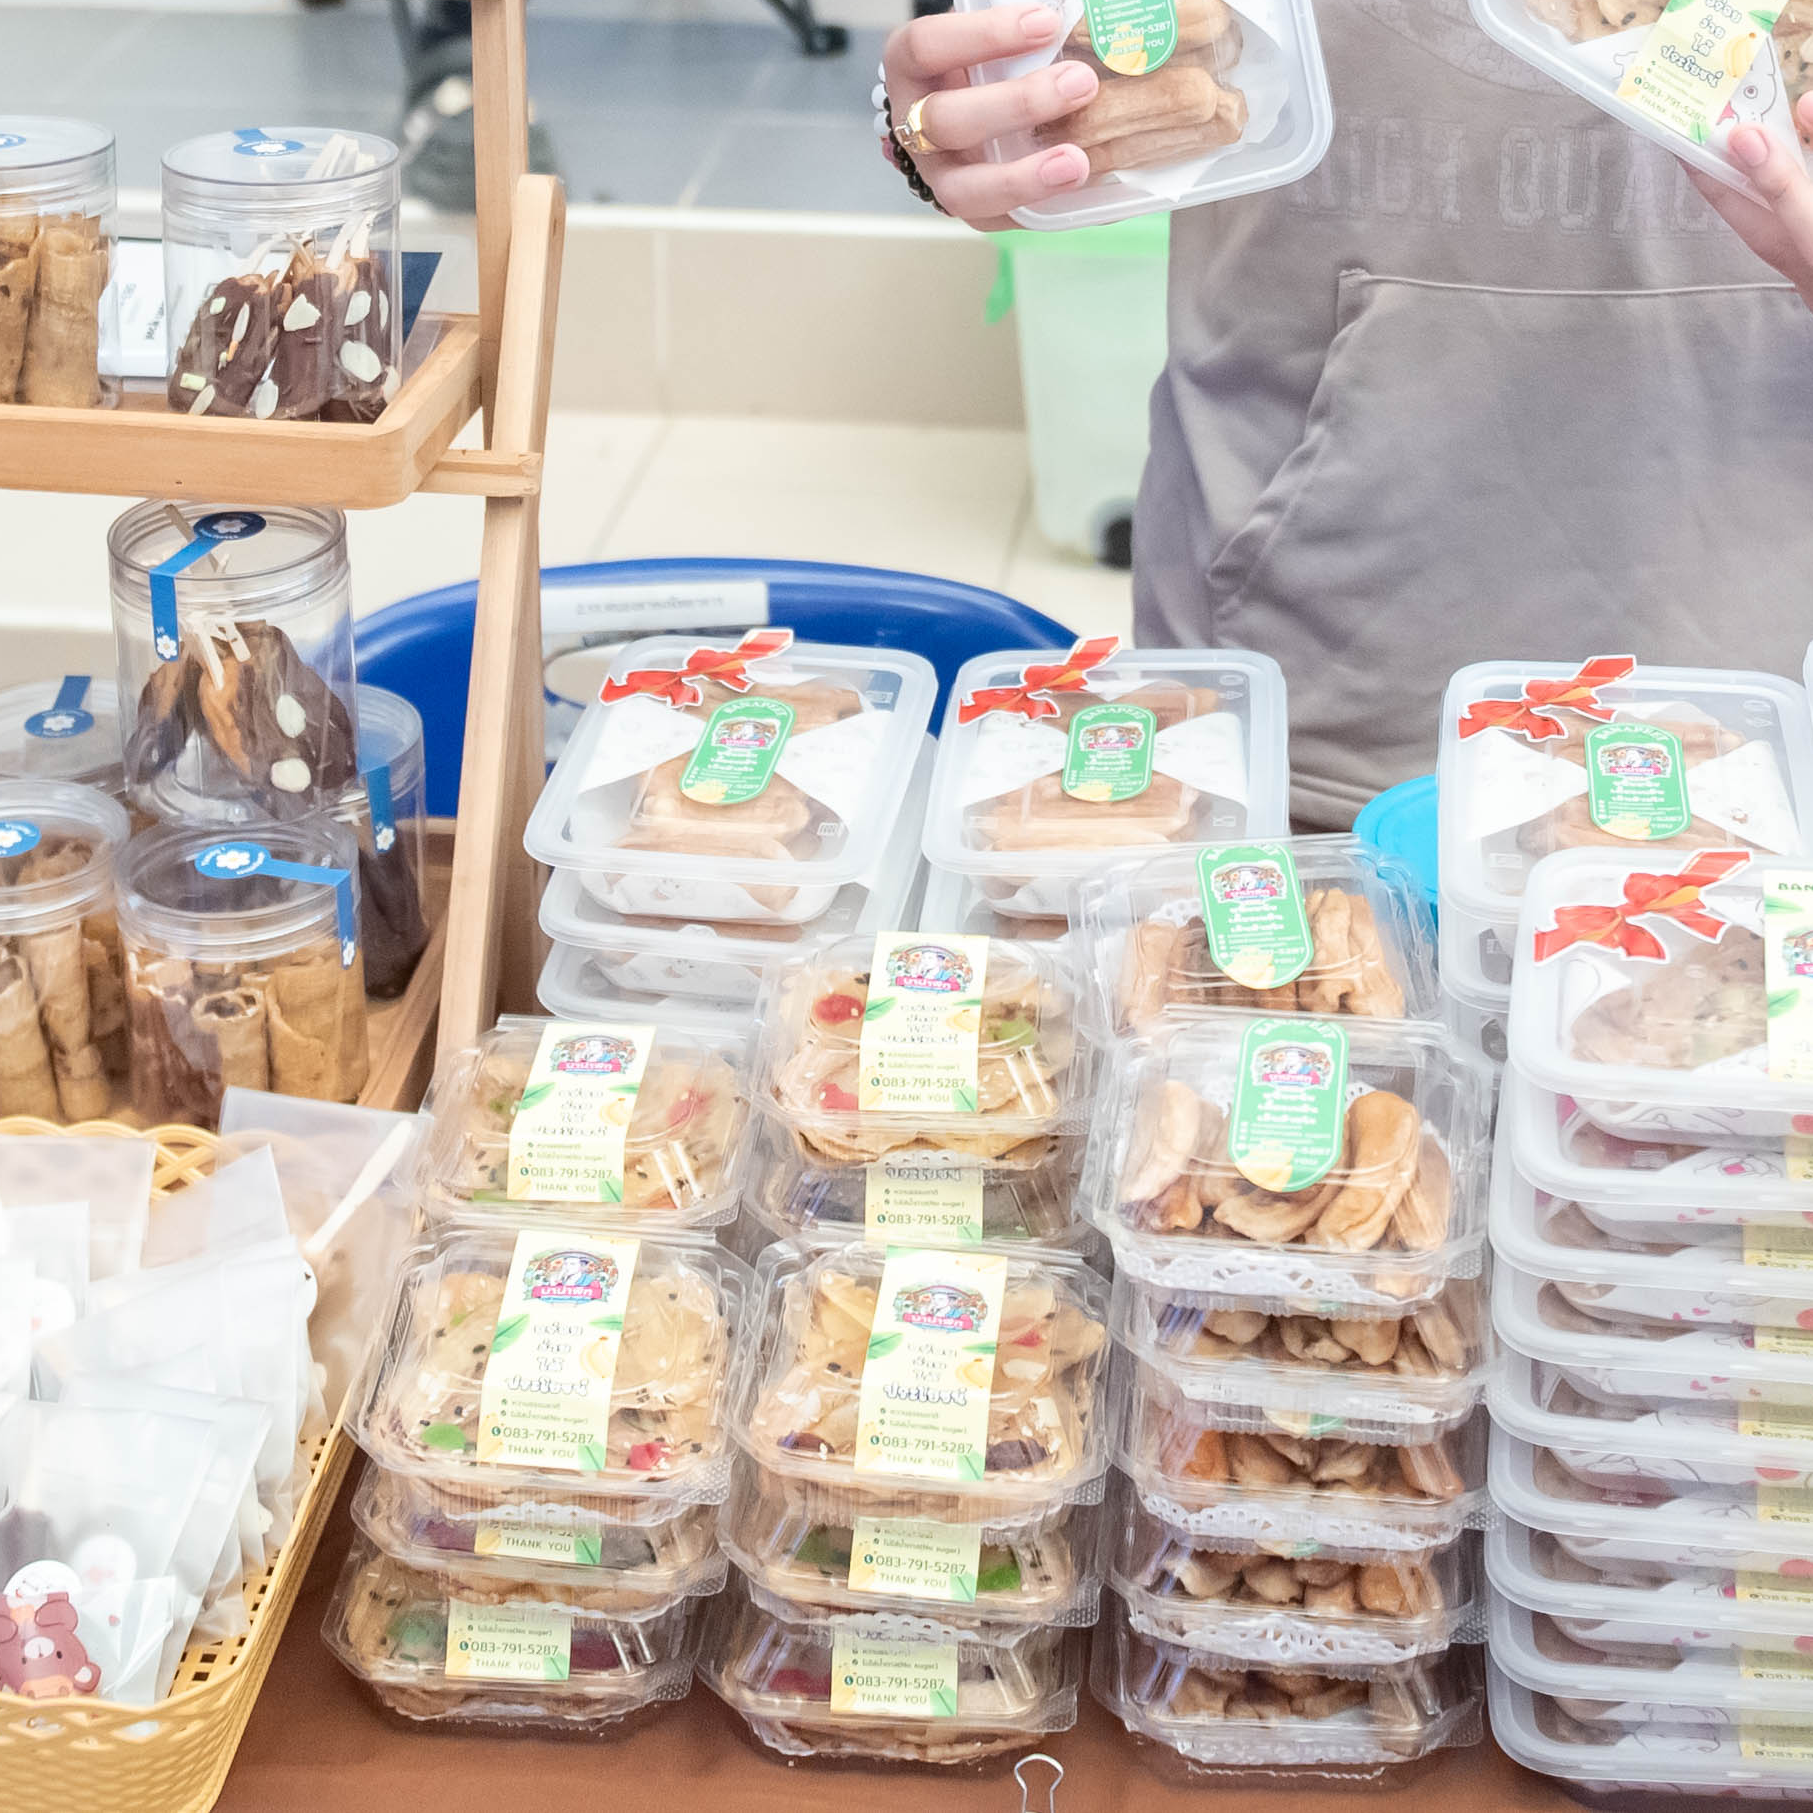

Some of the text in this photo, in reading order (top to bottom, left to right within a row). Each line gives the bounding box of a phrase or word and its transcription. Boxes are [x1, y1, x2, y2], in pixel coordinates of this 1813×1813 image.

[1145, 38, 1165, 49] YOU
[1642, 79, 1708, 123] 083-791-5287
[882, 1077, 966, 1089] 083-791-5287
[530, 1166, 613, 1179] 083-791-5287
[887, 1214, 971, 1226] 083-791-5287
[503, 1427, 594, 1444] 083-791-5287
[508, 1444, 575, 1459] THANK YOU
[882, 1435, 973, 1454] 083-791-5287
[886, 1453, 955, 1468] THANK YOU
[505, 1537, 572, 1552] THANK YOU
[876, 1554, 966, 1575] 083-791-5287
[879, 1573, 947, 1588] THANK YOU
[470, 1640, 559, 1656] 083-791-5287
[475, 1658, 541, 1672] THANK YOU
[855, 1674, 945, 1690] 083-791-5287
[861, 1692, 927, 1704] THANK YOU
